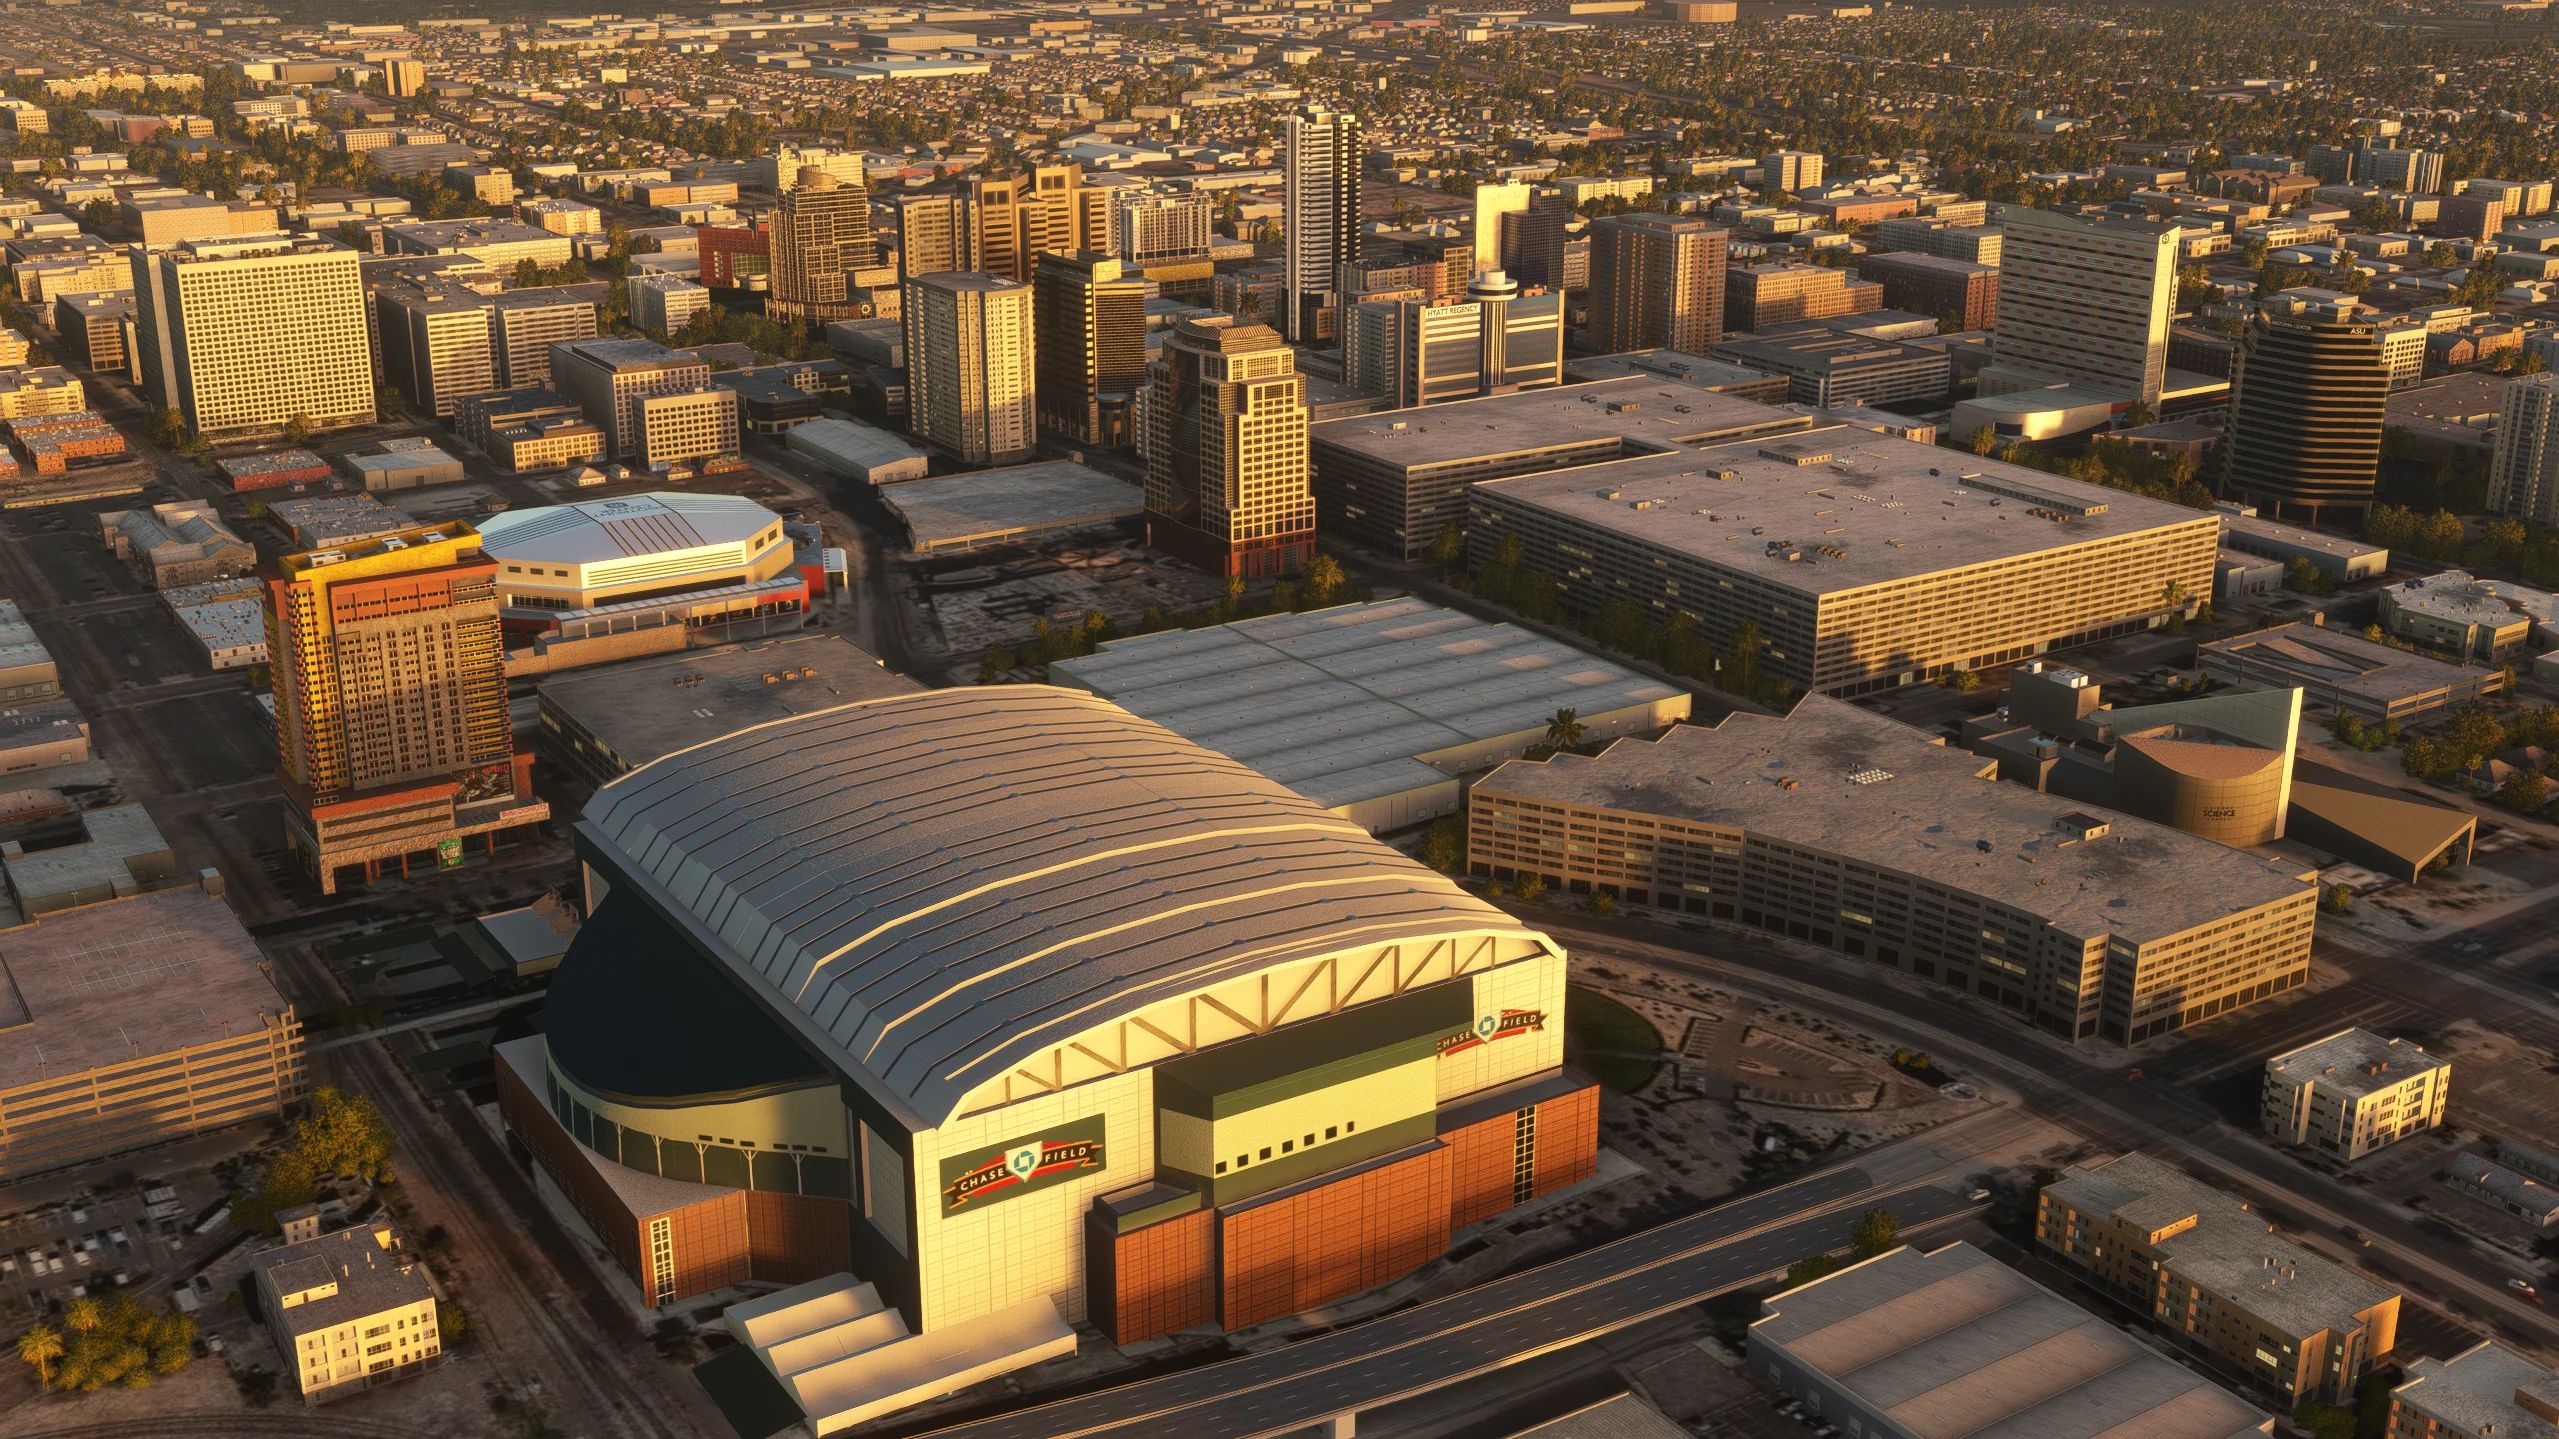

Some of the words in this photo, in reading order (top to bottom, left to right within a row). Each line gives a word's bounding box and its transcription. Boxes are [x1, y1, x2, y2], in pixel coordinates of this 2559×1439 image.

[1427, 307, 1449, 317] HYATT
[1450, 304, 1479, 314] REGENCY
[2350, 327, 2366, 335] ASU
[1503, 1014, 1537, 1028] FIELD
[960, 1168, 1004, 1191] CHASE
[1045, 1147, 1087, 1163] FIELD
